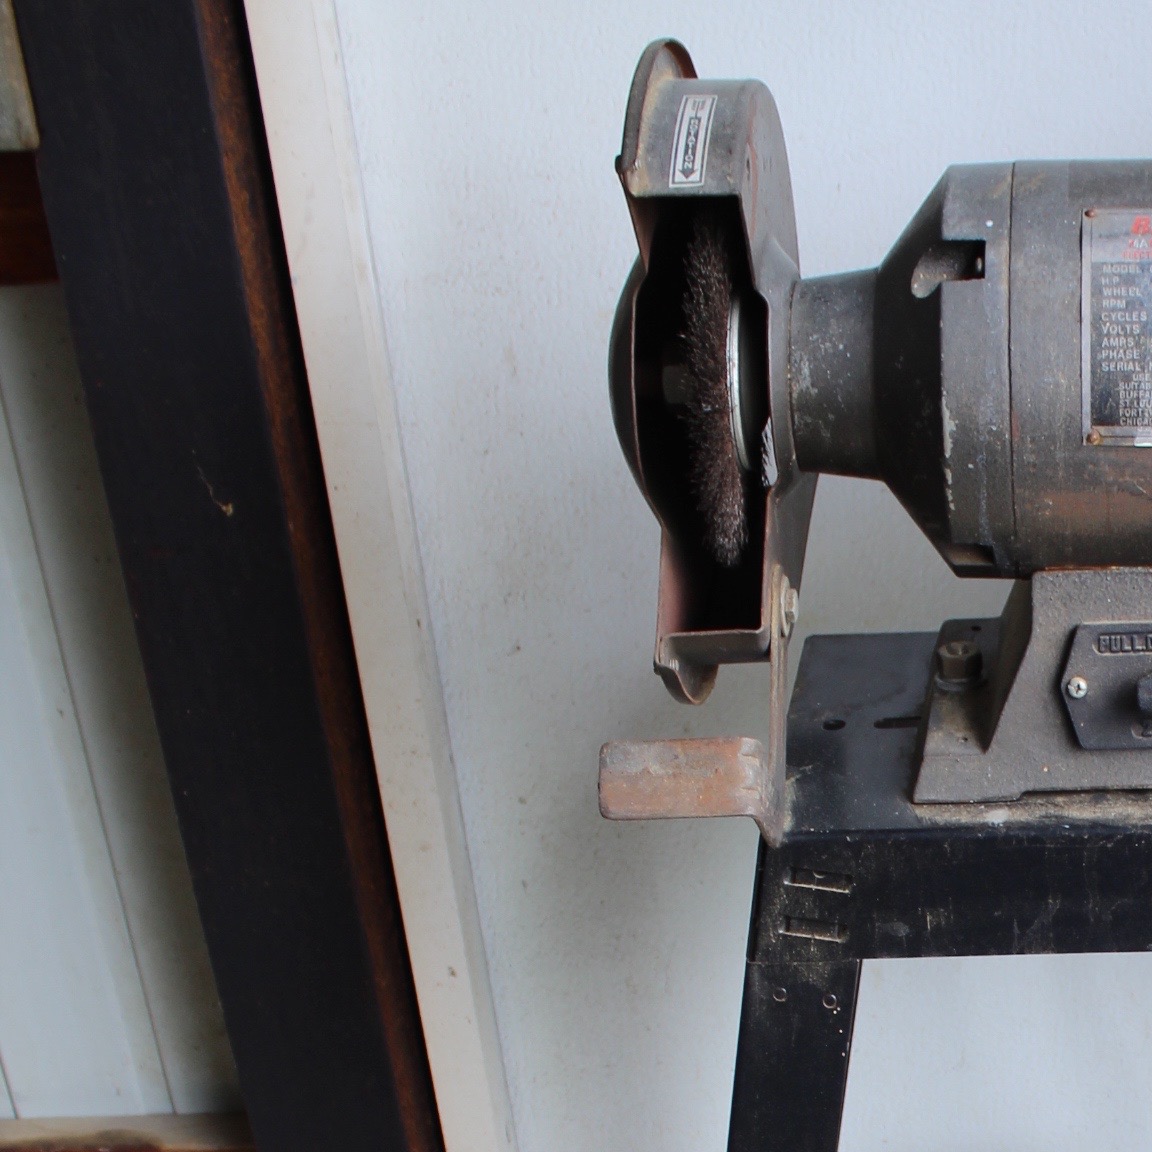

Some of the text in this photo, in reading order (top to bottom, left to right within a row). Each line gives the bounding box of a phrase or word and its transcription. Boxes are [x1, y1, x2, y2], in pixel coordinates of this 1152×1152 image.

[1102, 264, 1142, 274] MODEL
[1102, 287, 1142, 297] WHEEL
[1102, 299, 1127, 309] RPM
[1101, 311, 1147, 322] CYCLES
[1101, 324, 1141, 335] VOLTS
[1101, 350, 1141, 360] PHASE
[1101, 362, 1142, 372] SERIAL
[1133, 373, 1151, 382] USE
[1119, 408, 1144, 417] FORT
